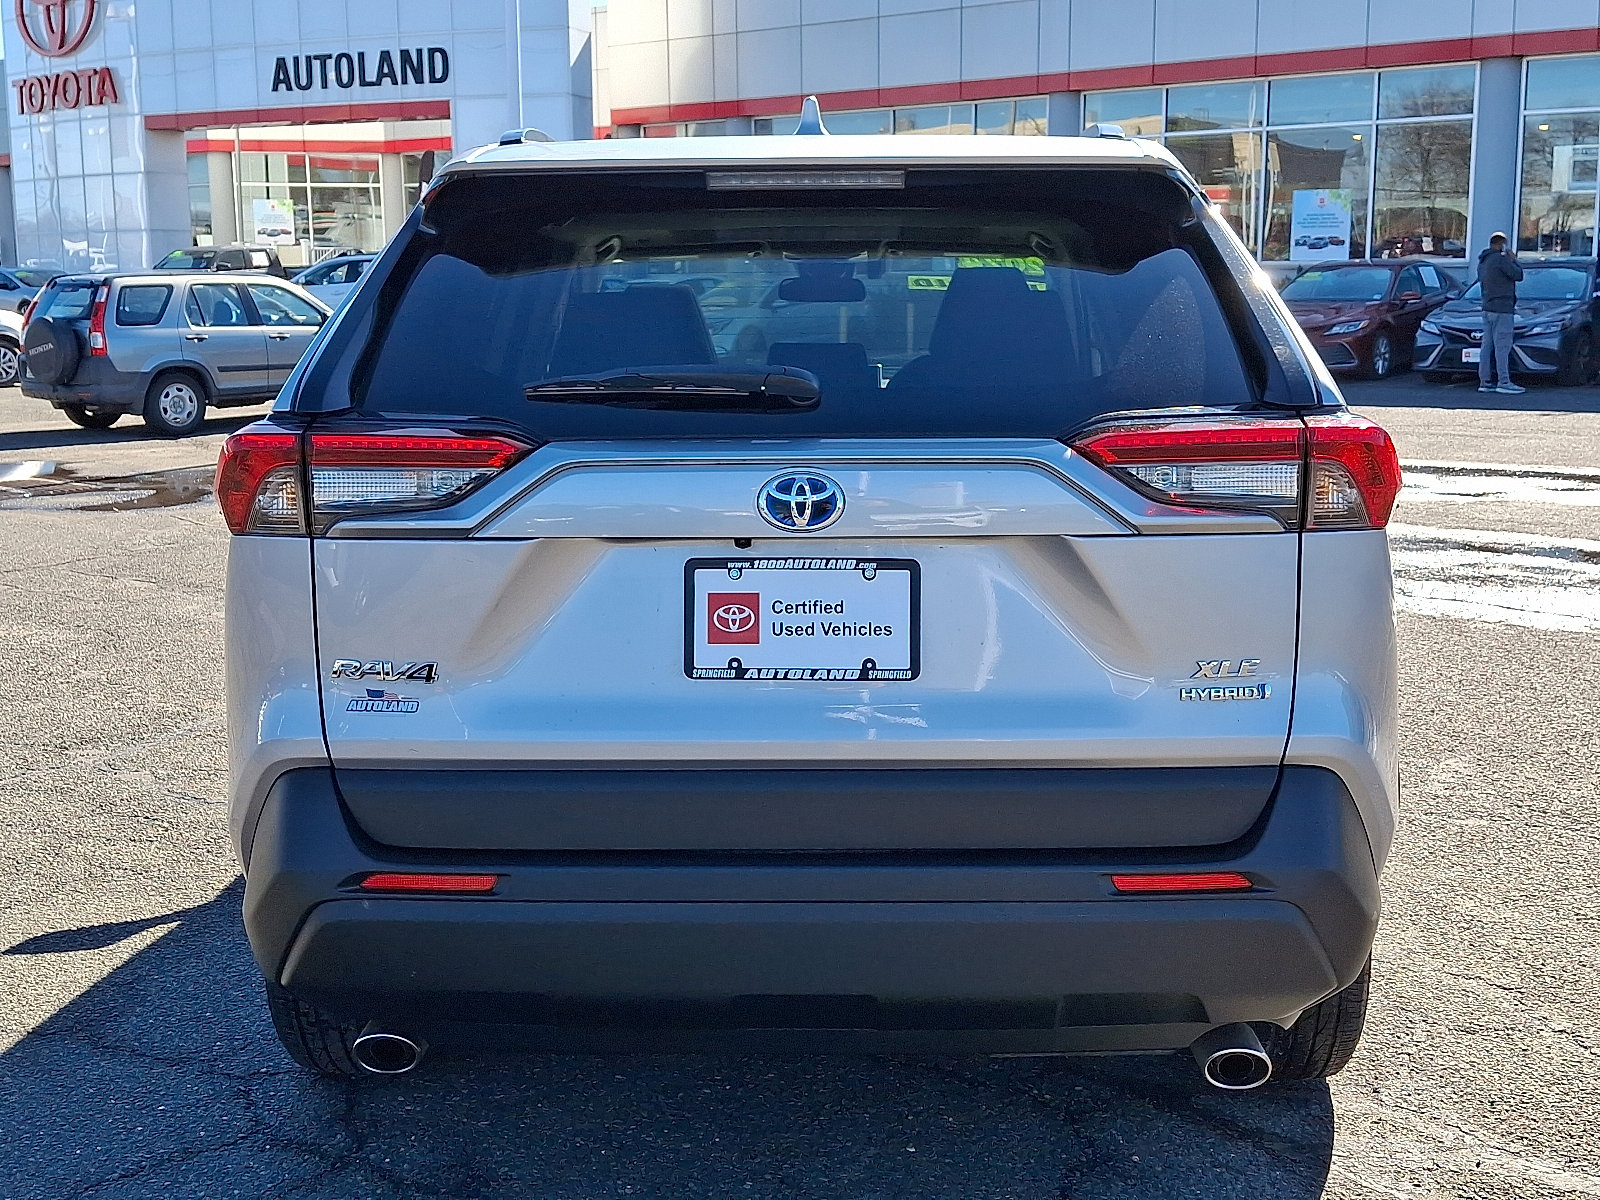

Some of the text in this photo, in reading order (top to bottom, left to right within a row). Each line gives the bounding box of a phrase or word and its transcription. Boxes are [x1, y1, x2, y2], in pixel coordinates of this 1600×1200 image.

[271, 47, 449, 92] AUTOLAND
[12, 65, 118, 114] TOYOTA
[28, 342, 54, 356] HONDA
[727, 558, 877, 570] www.1800AUTOLAND.com
[771, 599, 844, 615] Certified
[771, 622, 893, 637] Used Vehicles
[331, 658, 439, 684] RAV4
[692, 668, 912, 679] SPRINGFIELD AUTOLAND SPRINGFIELD
[1190, 658, 1261, 679] XLE
[1180, 685, 1258, 701] HYBRID
[347, 700, 419, 712] AUTOLAND
